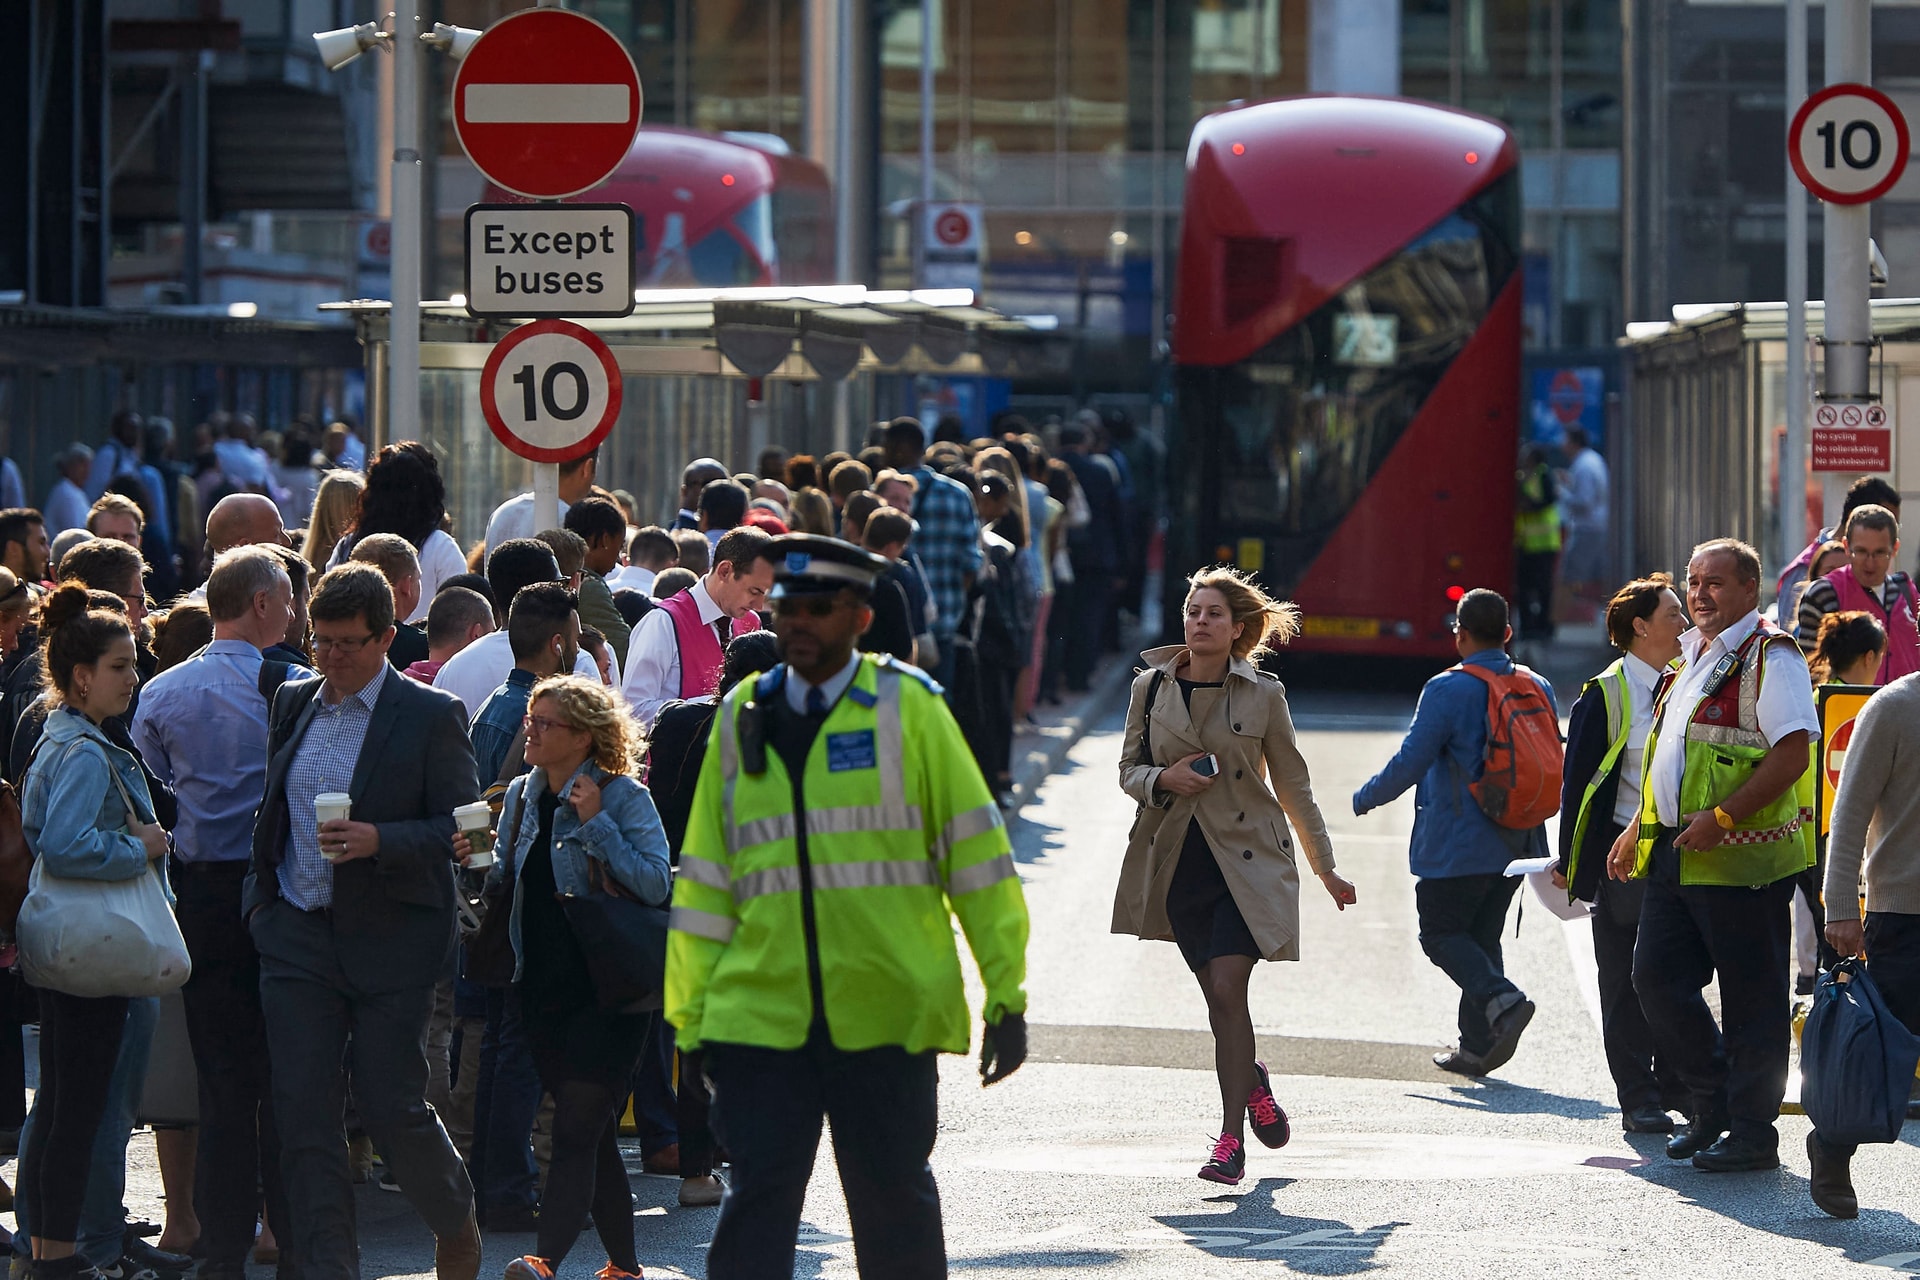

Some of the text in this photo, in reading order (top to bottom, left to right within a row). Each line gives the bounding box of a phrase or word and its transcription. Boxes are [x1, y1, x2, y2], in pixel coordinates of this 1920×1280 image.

[1817, 119, 1882, 170] 10
[484, 224, 615, 260] Except
[495, 265, 605, 294] buses
[513, 361, 590, 422] 10
[1815, 431, 1857, 443] No cycling
[1815, 444, 1879, 455] No rollerskating
[1815, 457, 1885, 468] No skateboarding
